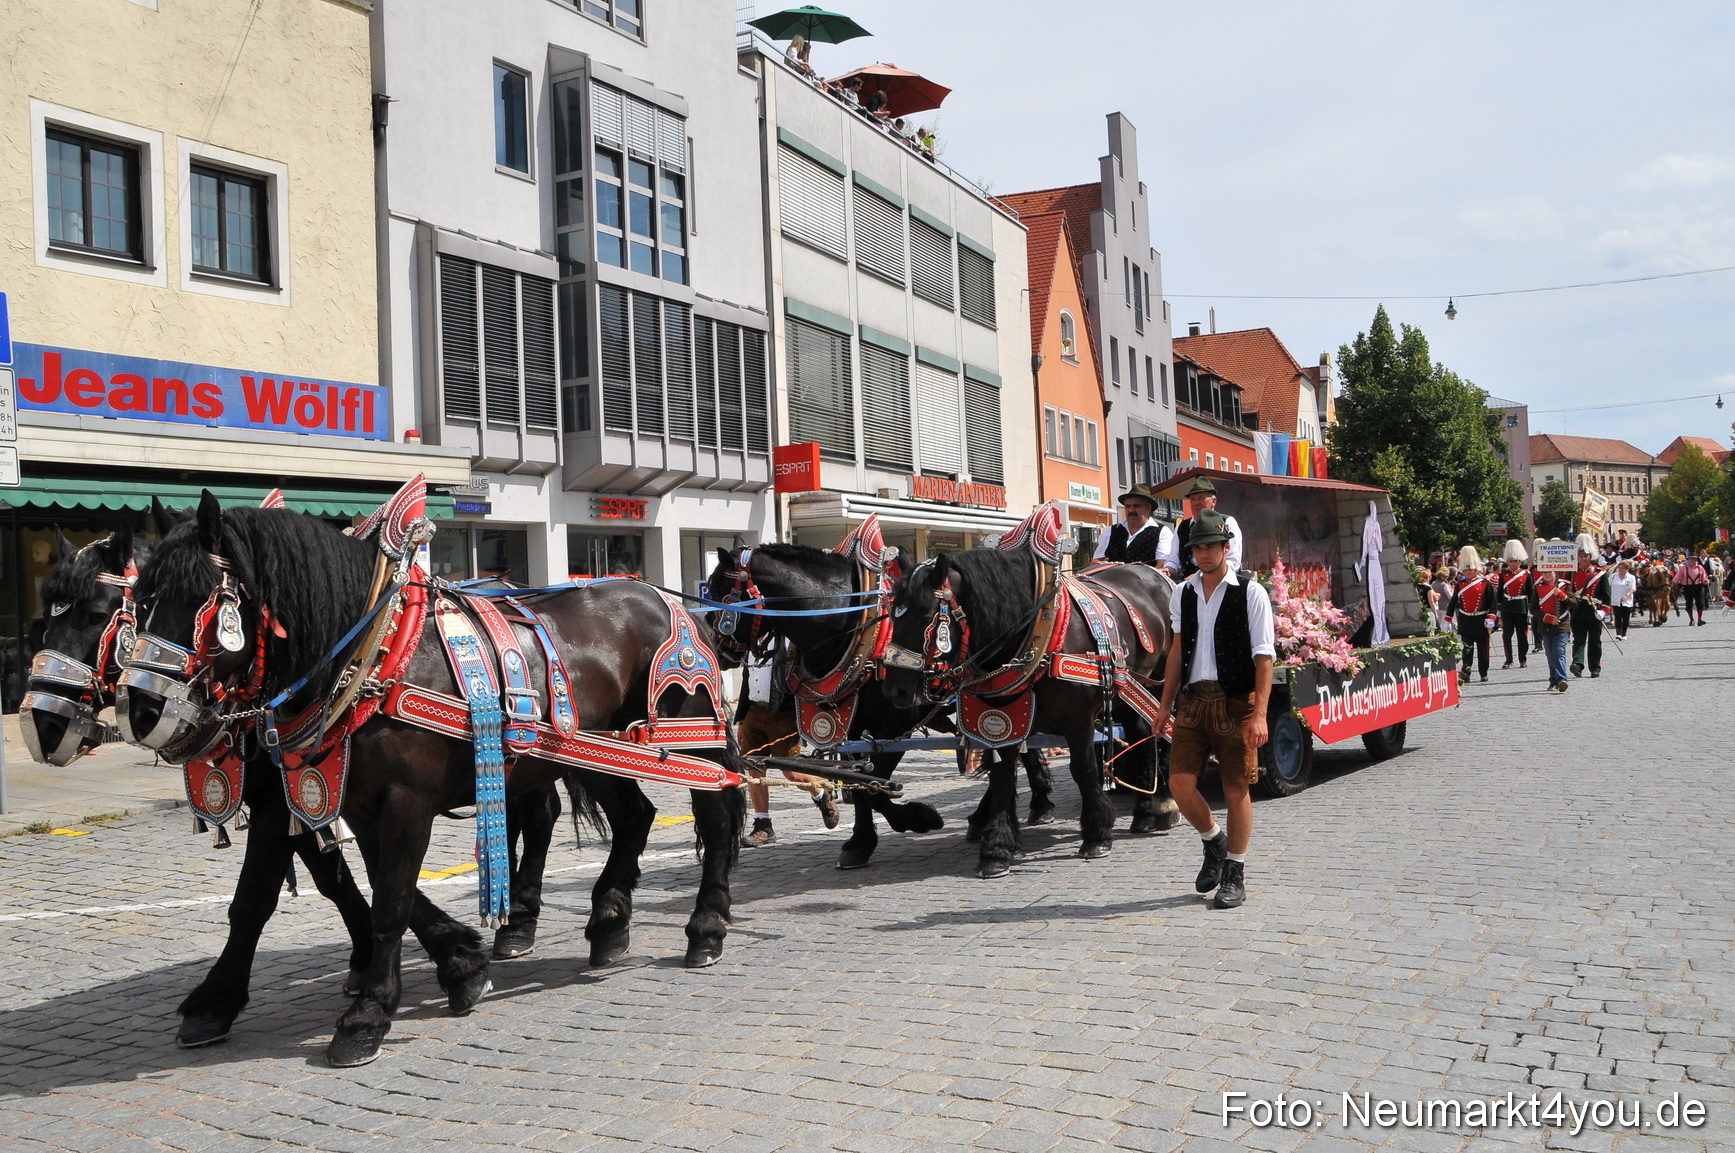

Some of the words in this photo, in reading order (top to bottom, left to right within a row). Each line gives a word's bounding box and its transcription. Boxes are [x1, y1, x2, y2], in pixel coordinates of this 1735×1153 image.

[18, 352, 225, 419] Jeans
[240, 376, 375, 433] Wölfl
[775, 460, 813, 476] ESPRIT
[911, 474, 1008, 508] MARIEN-APOTHEKE
[600, 497, 649, 520] ESPRIT
[1315, 684, 1343, 732] Der
[1423, 660, 1449, 709] Jung
